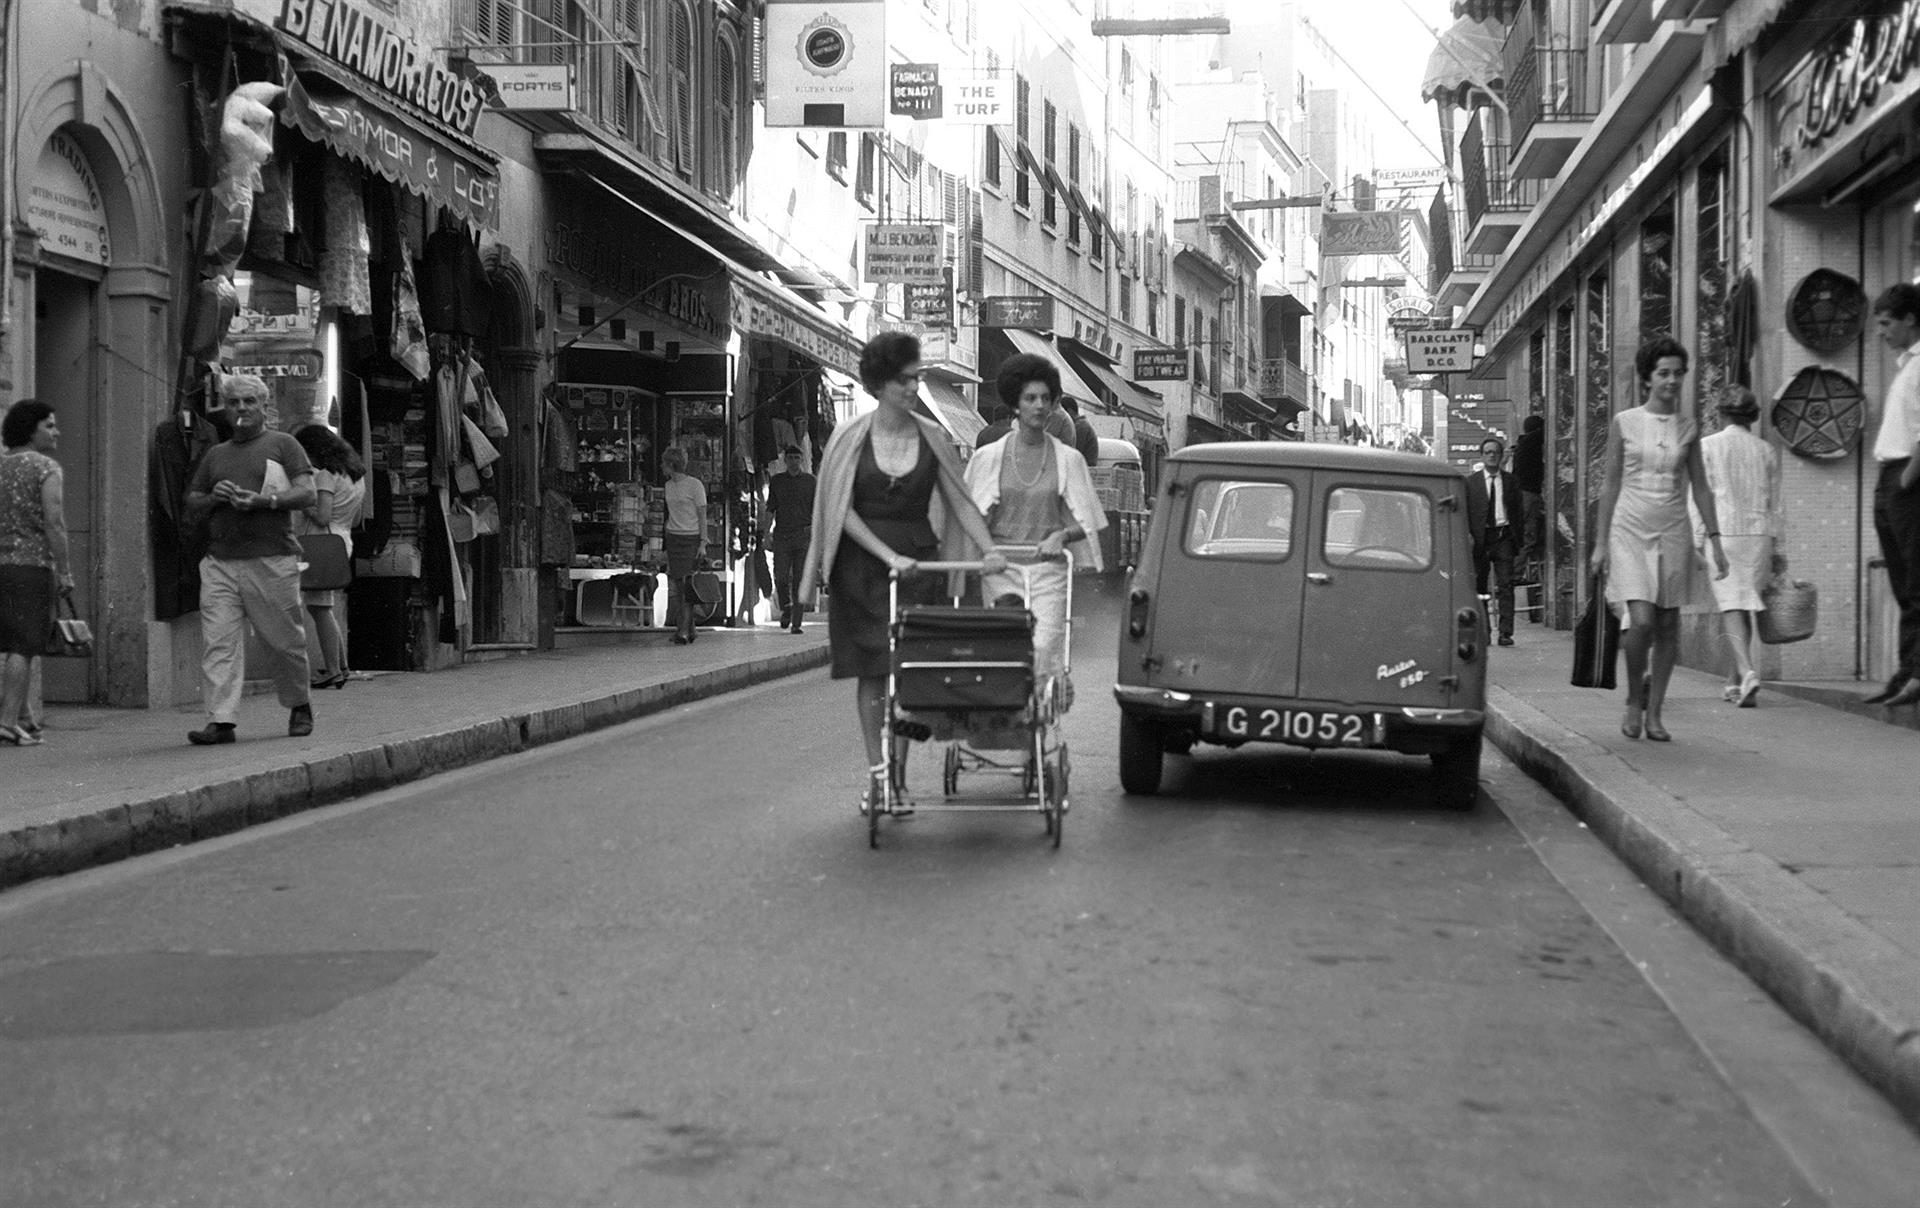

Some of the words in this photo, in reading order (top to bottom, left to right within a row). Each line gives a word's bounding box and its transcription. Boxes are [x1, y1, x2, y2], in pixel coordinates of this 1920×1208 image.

[502, 82, 563, 91] FORTIS
[894, 85, 936, 97] BENADY
[960, 86, 995, 98] THE
[954, 103, 1001, 115] TURF
[1378, 169, 1441, 180] RESTAURANT
[1410, 334, 1471, 343] BARCLAYS
[1424, 346, 1457, 355] BANK
[1137, 366, 1186, 377] FOOTWEAR
[1376, 659, 1417, 680] Austin
[1227, 706, 1248, 735] G
[1259, 708, 1362, 742] 21052
